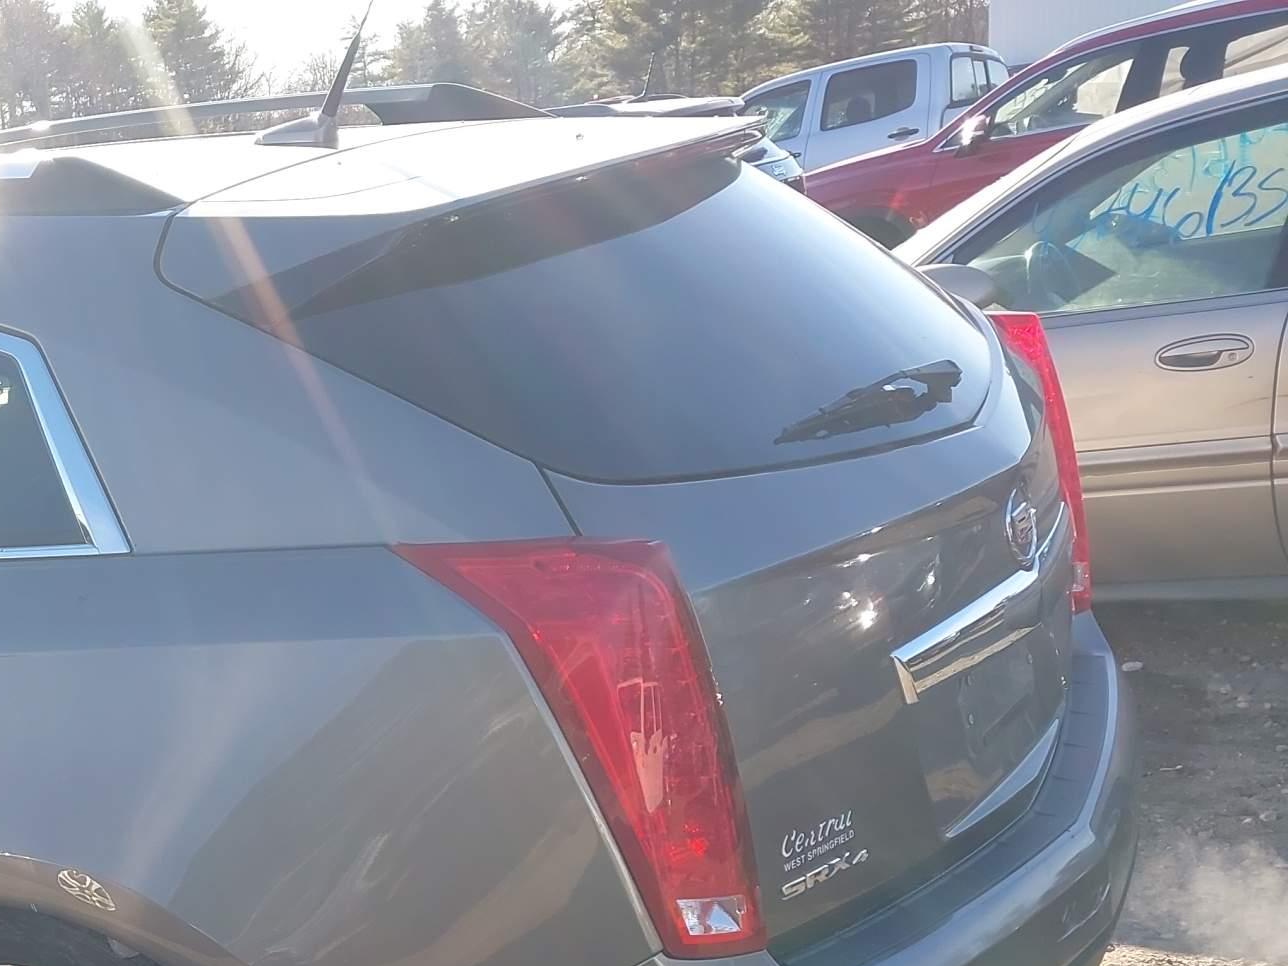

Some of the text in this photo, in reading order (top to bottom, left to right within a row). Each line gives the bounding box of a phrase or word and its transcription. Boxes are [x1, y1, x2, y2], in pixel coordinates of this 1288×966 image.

[782, 810, 852, 858] Central
[783, 829, 855, 872] WEST SPRINGFIELD
